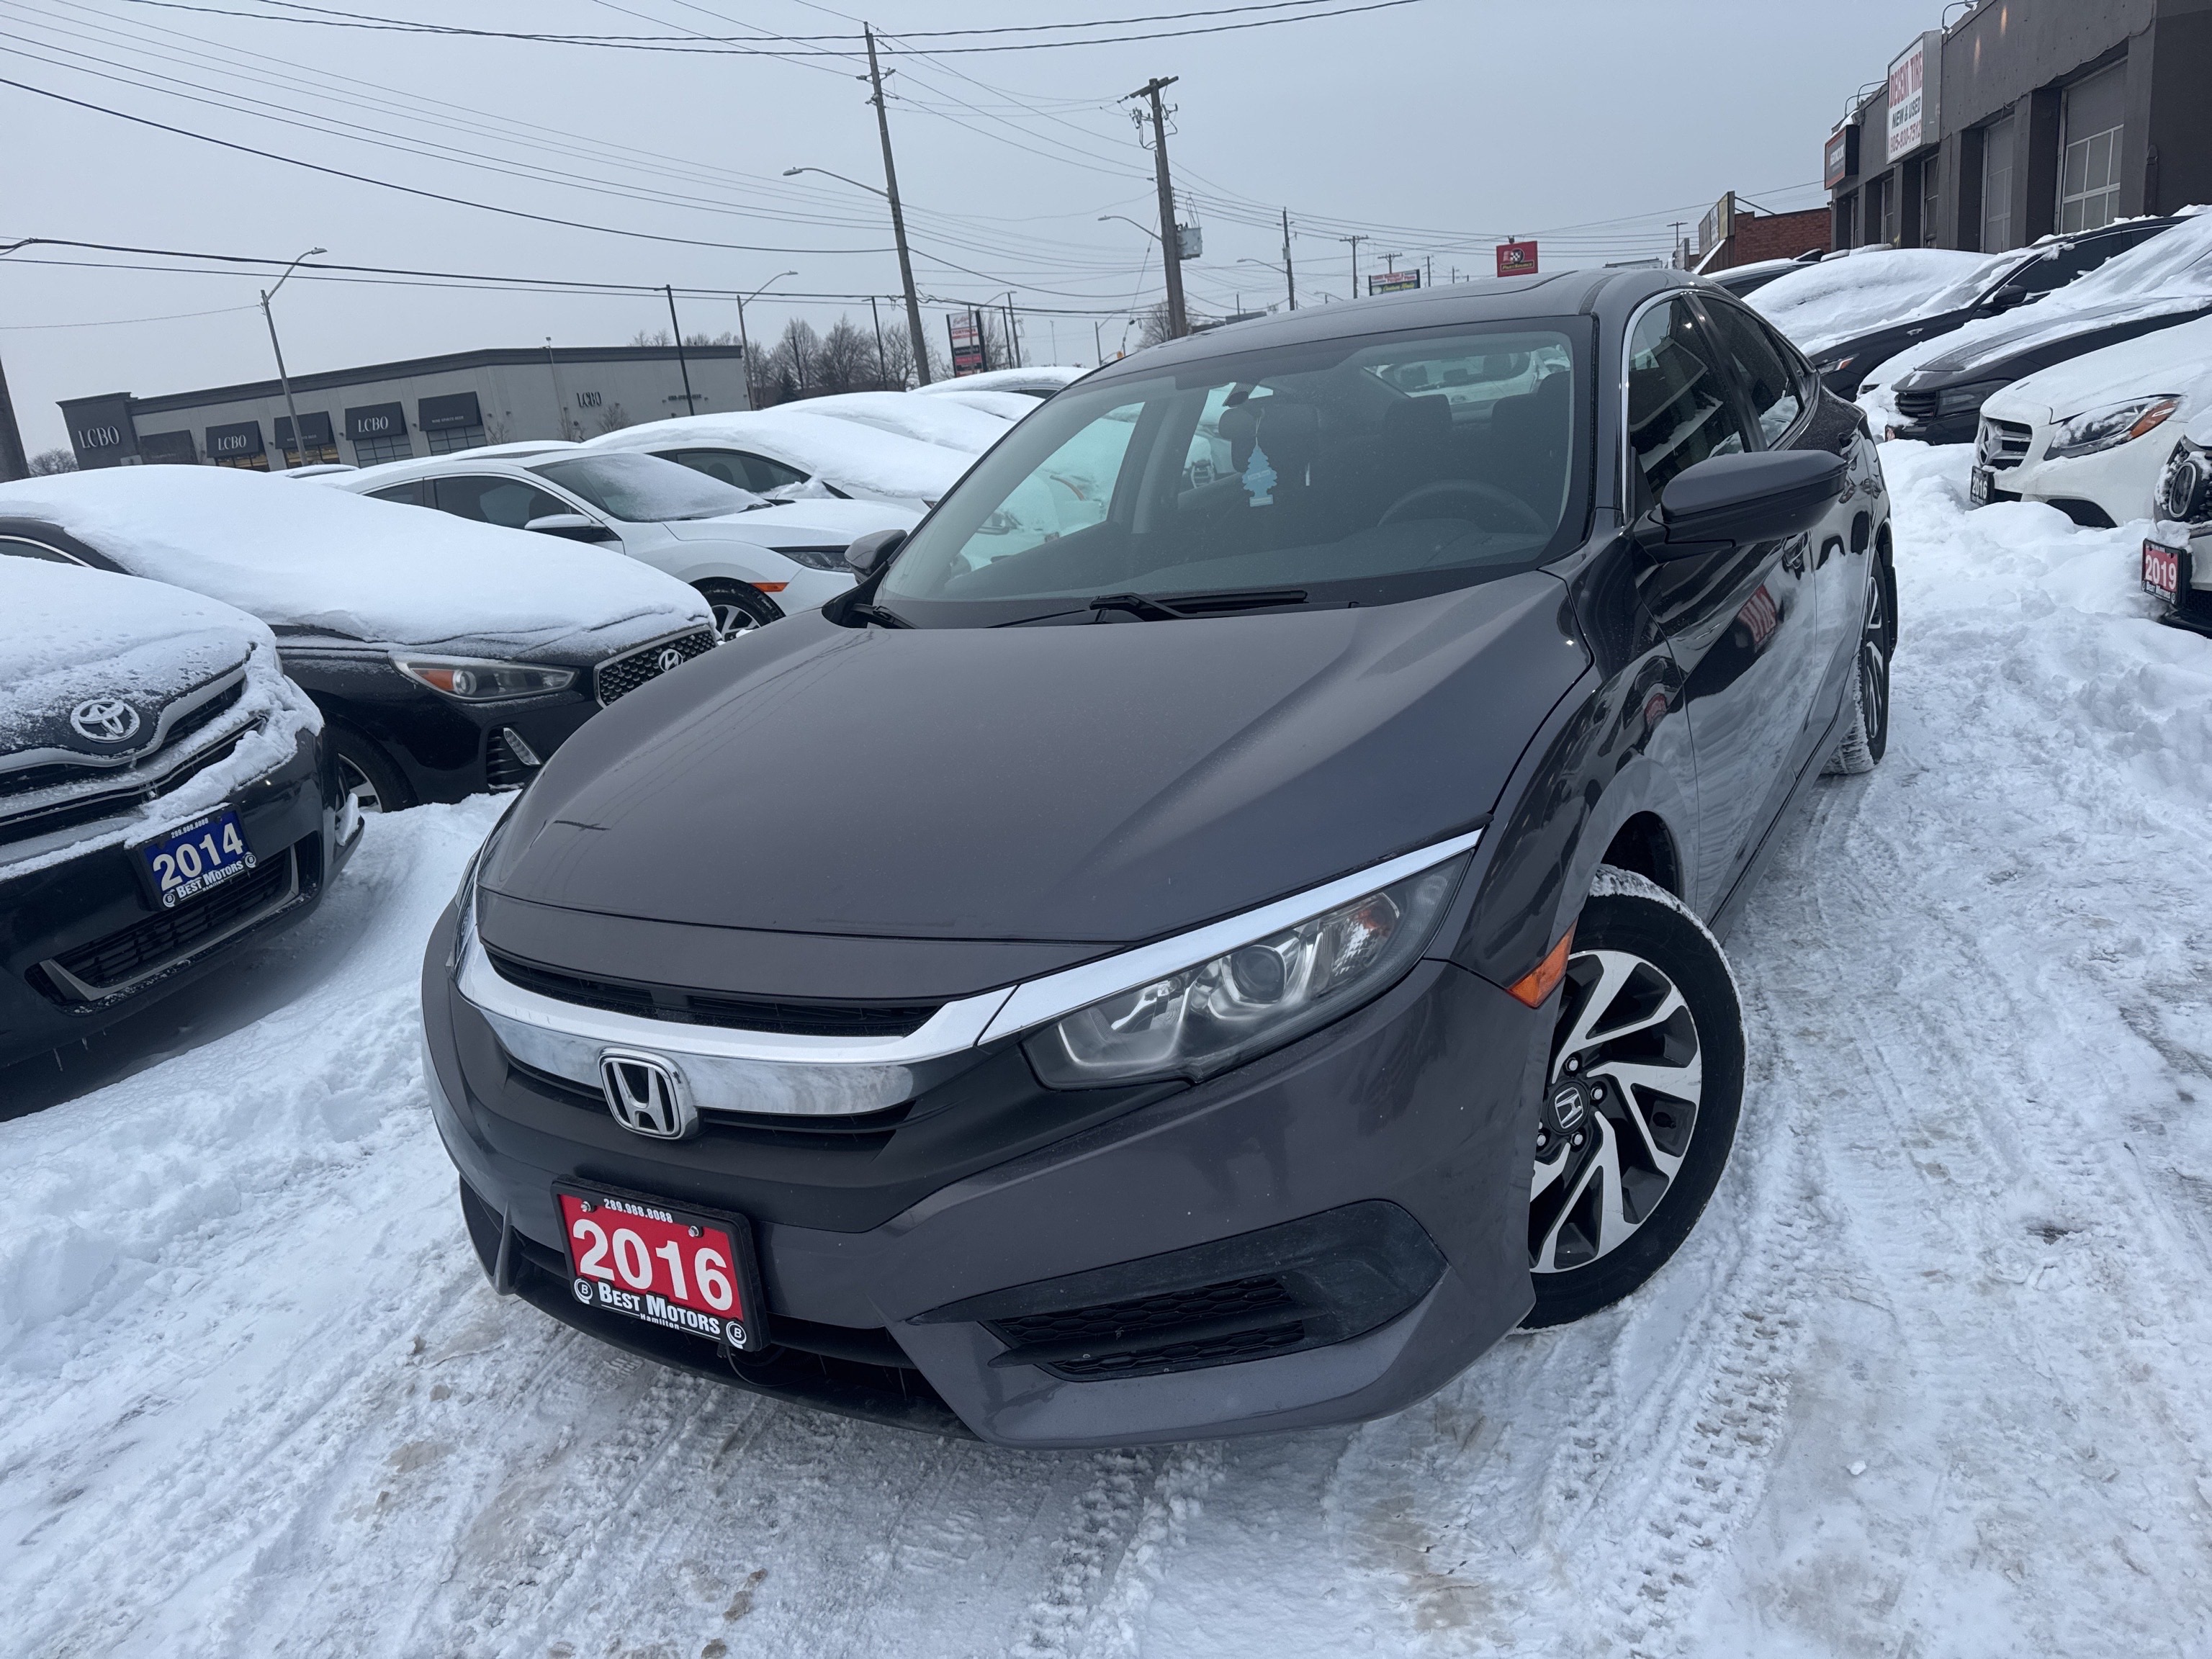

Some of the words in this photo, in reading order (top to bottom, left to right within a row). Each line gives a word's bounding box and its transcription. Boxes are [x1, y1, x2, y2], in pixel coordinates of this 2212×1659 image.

[1889, 60, 1909, 109] DECENT
[1910, 50, 1922, 94] TIRE
[1892, 107, 1903, 129] NEW
[1909, 95, 1920, 120] USED
[576, 391, 602, 408] LCBO
[78, 425, 120, 449] LCBO
[358, 415, 389, 433] LCBO
[217, 434, 247, 451] LCBO
[1972, 476, 1987, 499] 2016
[2146, 554, 2176, 590] 2019
[153, 822, 243, 891] 2014
[176, 879, 202, 899] BEST
[202, 860, 243, 884] MOTORS
[603, 1198, 673, 1223] 289.988.8088
[572, 1218, 733, 1311] 2016
[598, 1281, 640, 1312] BEST
[646, 1294, 721, 1334] MOTORS
[640, 1313, 680, 1330] Hamilton
